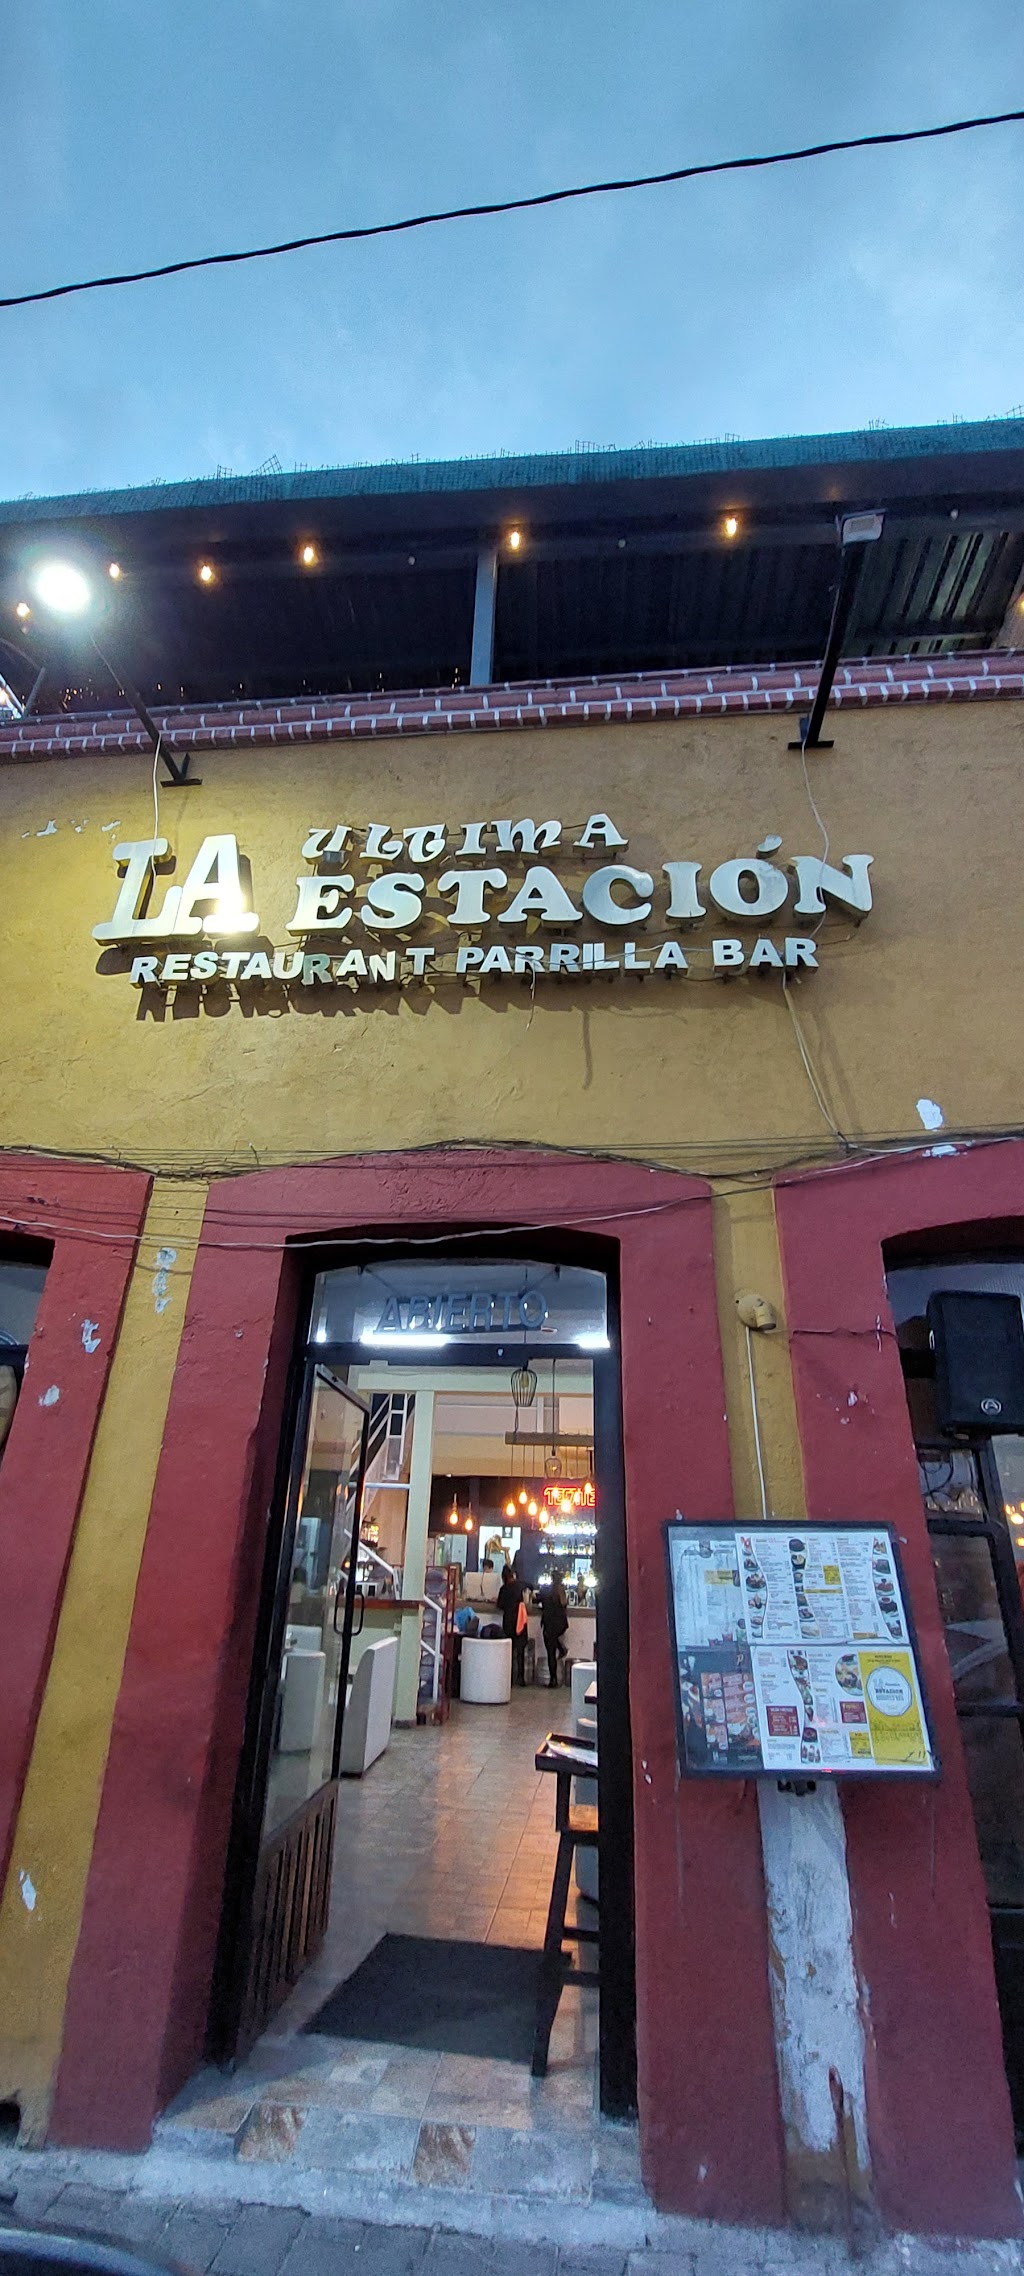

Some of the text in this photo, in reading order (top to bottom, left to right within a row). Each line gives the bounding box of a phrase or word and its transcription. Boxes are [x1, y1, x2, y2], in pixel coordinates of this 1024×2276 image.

[91, 833, 875, 943] LA ESTACIÓN
[129, 936, 820, 988] RESTAURANT PARRILLA BAR
[373, 1290, 548, 1334] ABIERTO
